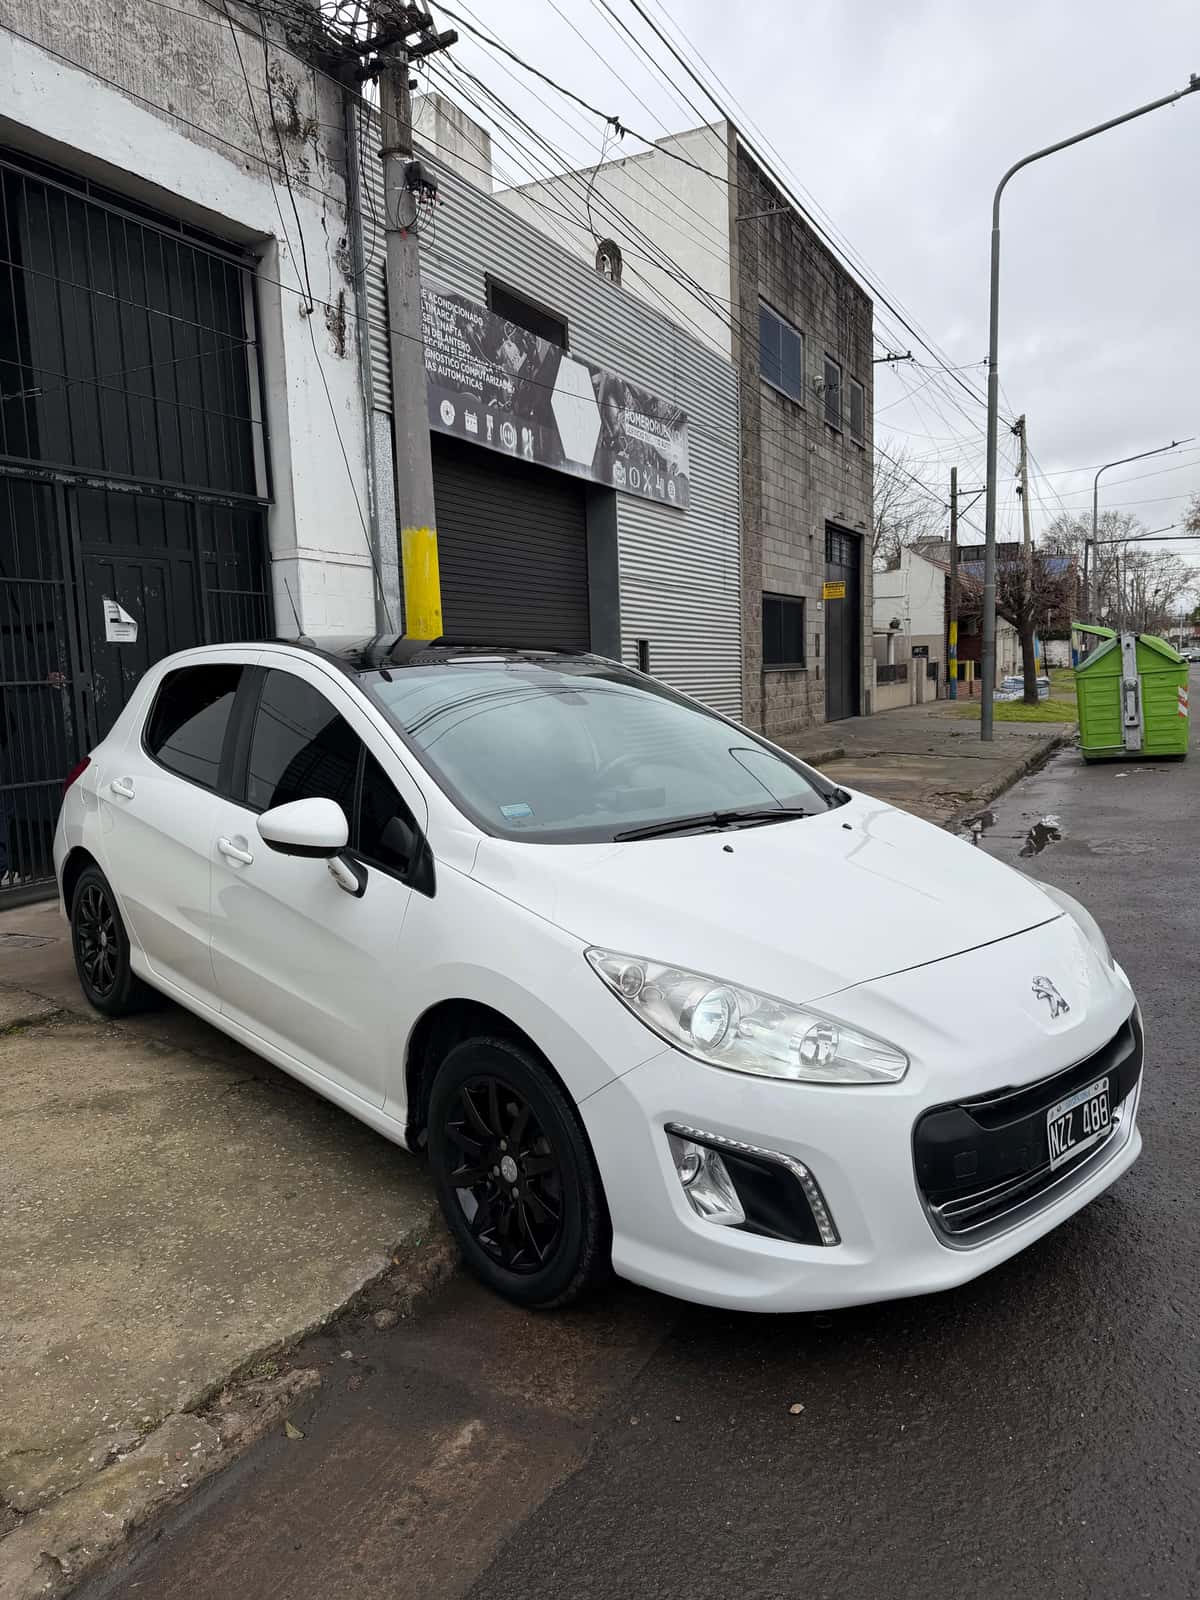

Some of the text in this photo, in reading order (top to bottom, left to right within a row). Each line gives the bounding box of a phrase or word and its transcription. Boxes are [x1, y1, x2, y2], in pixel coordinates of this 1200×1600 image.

[428, 292, 484, 326] ACONDICIONADO
[431, 328, 472, 353] DELANTERO
[441, 321, 463, 340] NAFTA
[1050, 1112, 1076, 1158] NZZ
[1083, 1094, 1109, 1134] 488
